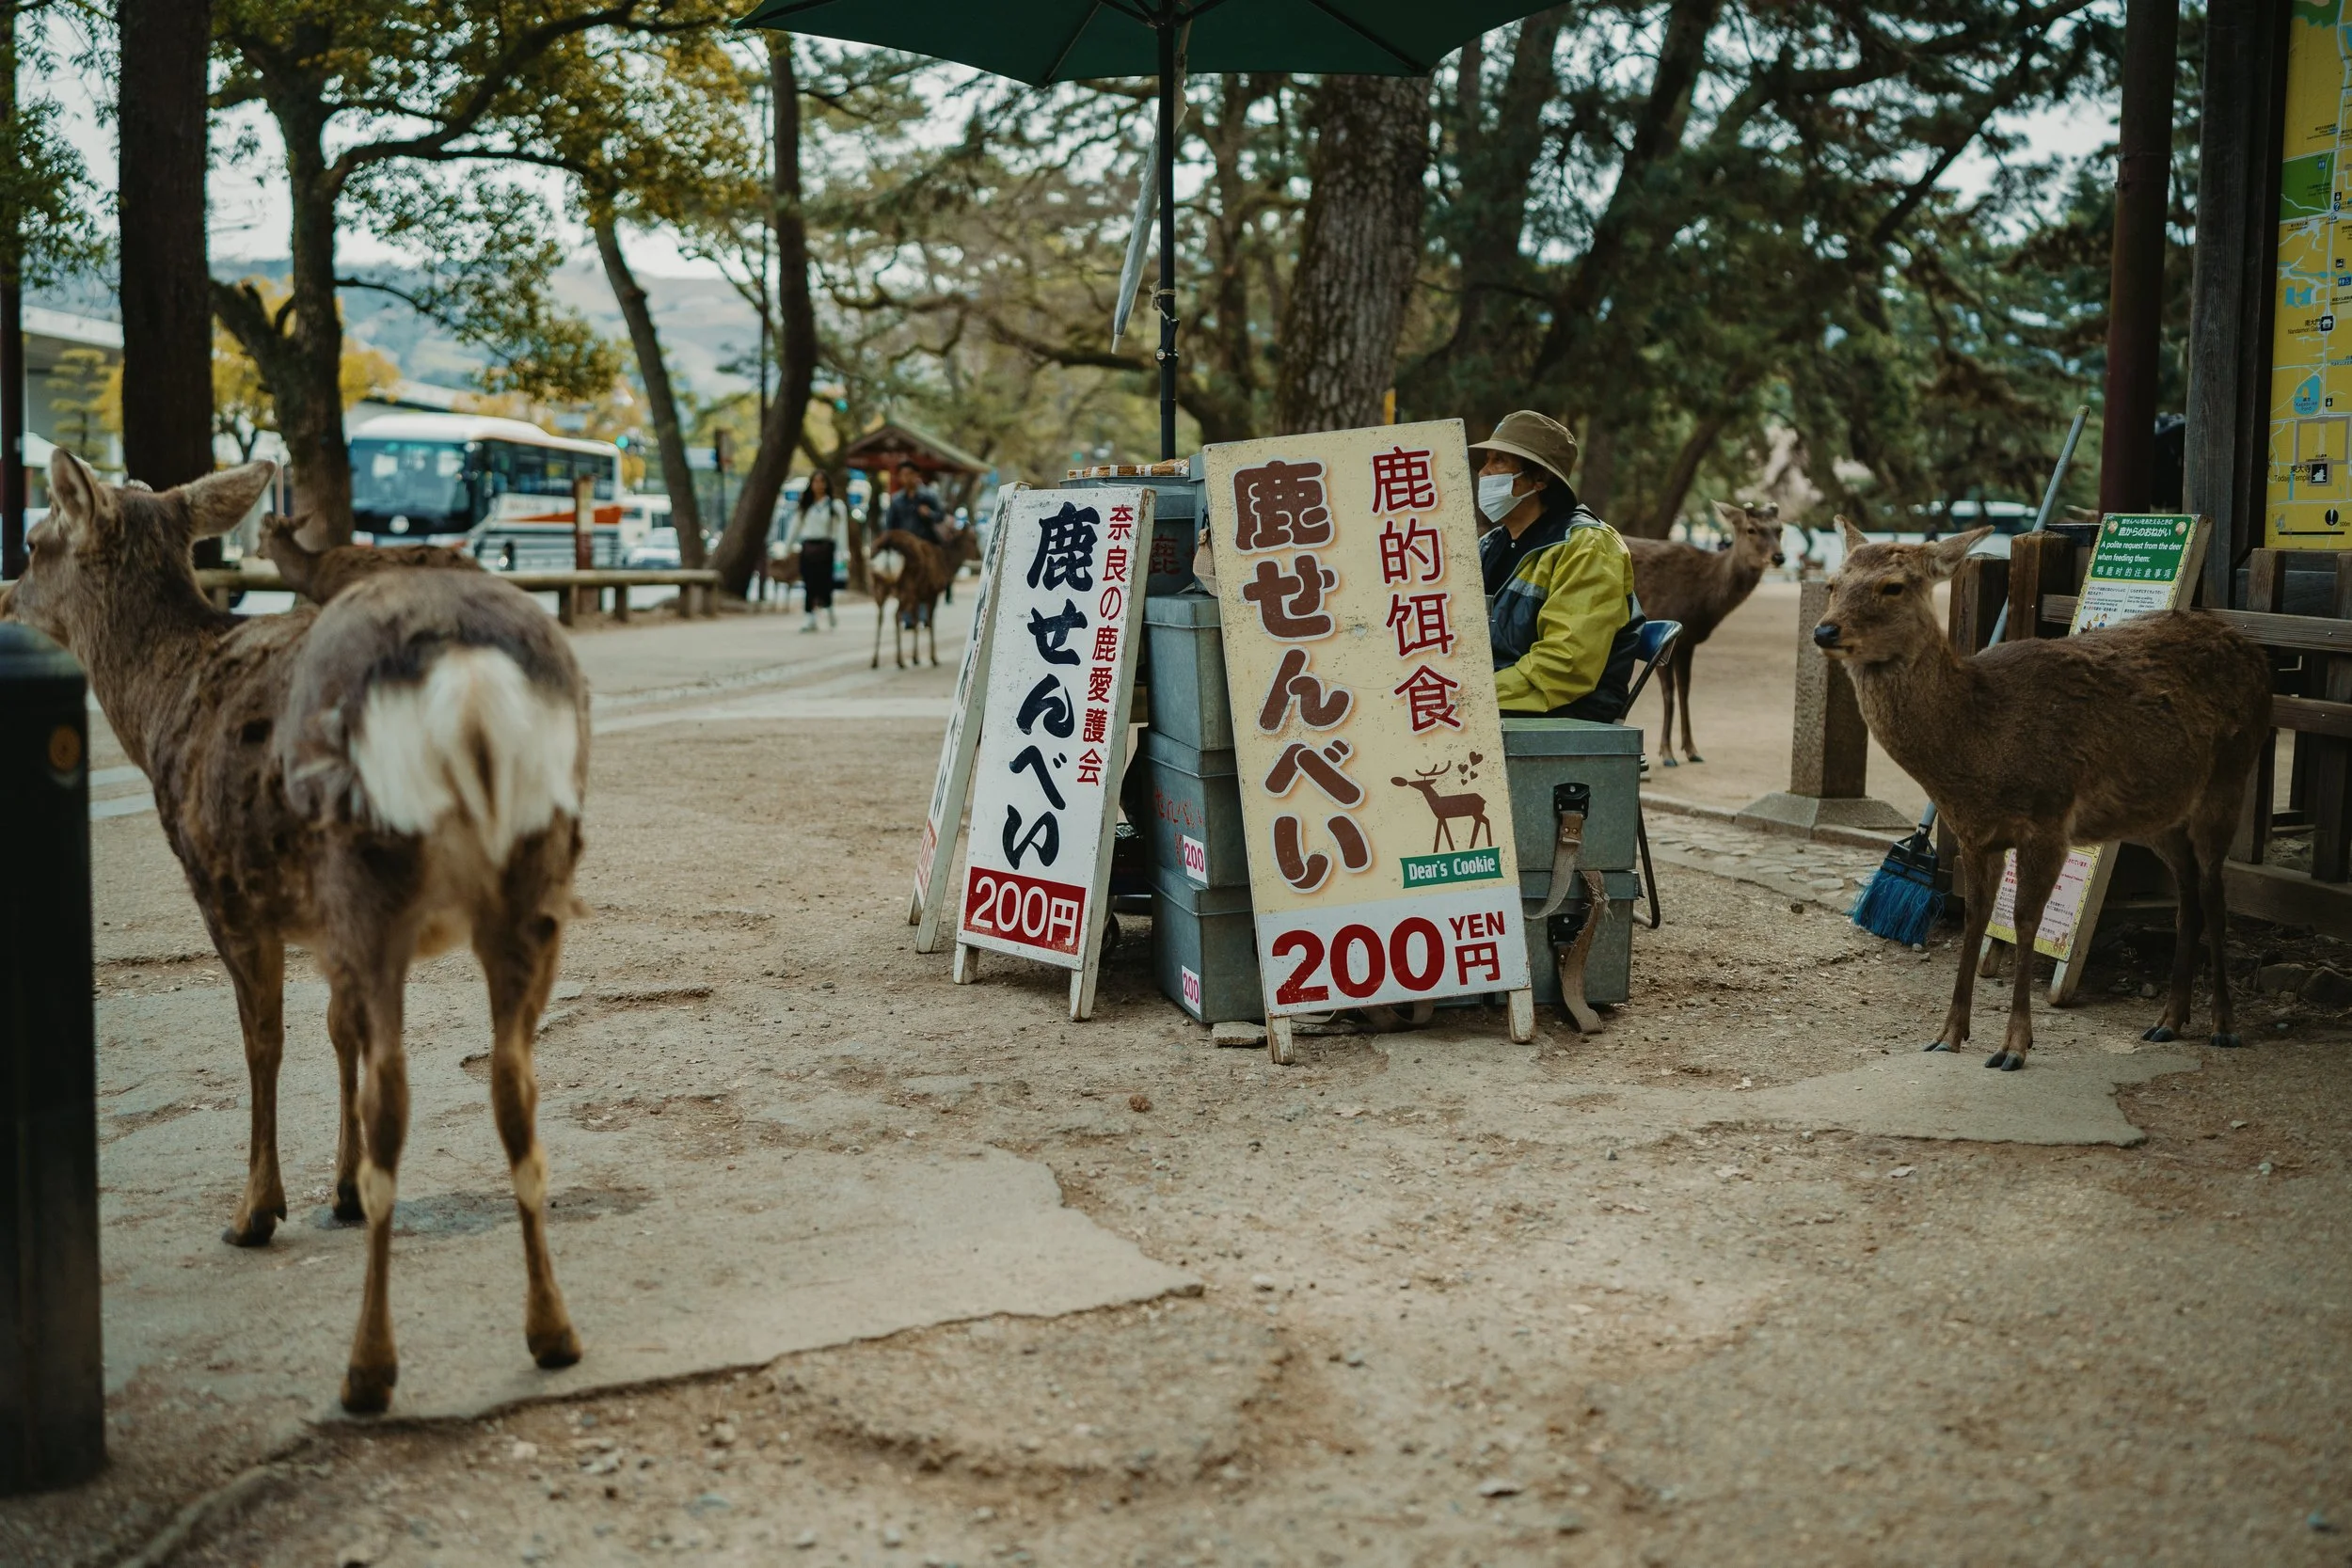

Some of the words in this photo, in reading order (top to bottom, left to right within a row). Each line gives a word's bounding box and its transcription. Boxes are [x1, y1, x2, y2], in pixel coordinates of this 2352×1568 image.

[2106, 540, 2122, 549] polite
[2122, 542, 2143, 550] request
[2144, 541, 2158, 549] from
[2168, 542, 2183, 550] deer
[2118, 527, 2171, 537] 鹿からのおねがい
[2113, 553, 2134, 564] feeding
[1372, 446, 1461, 732] 鹿的饵食
[1076, 504, 1134, 786] 奈良の鹿愛護会
[1002, 501, 1101, 870] 鹿せんべい
[1232, 460, 1369, 891] 鹿せんべい
[1184, 842, 1204, 873] 200
[1407, 861, 1448, 880] Dear's
[1453, 856, 1496, 876] Cookie
[971, 876, 1079, 946] 200円
[1449, 911, 1505, 941] YEN
[1271, 916, 1446, 1006] 200
[1454, 942, 1502, 986] 円
[1184, 973, 1199, 1005] 200
